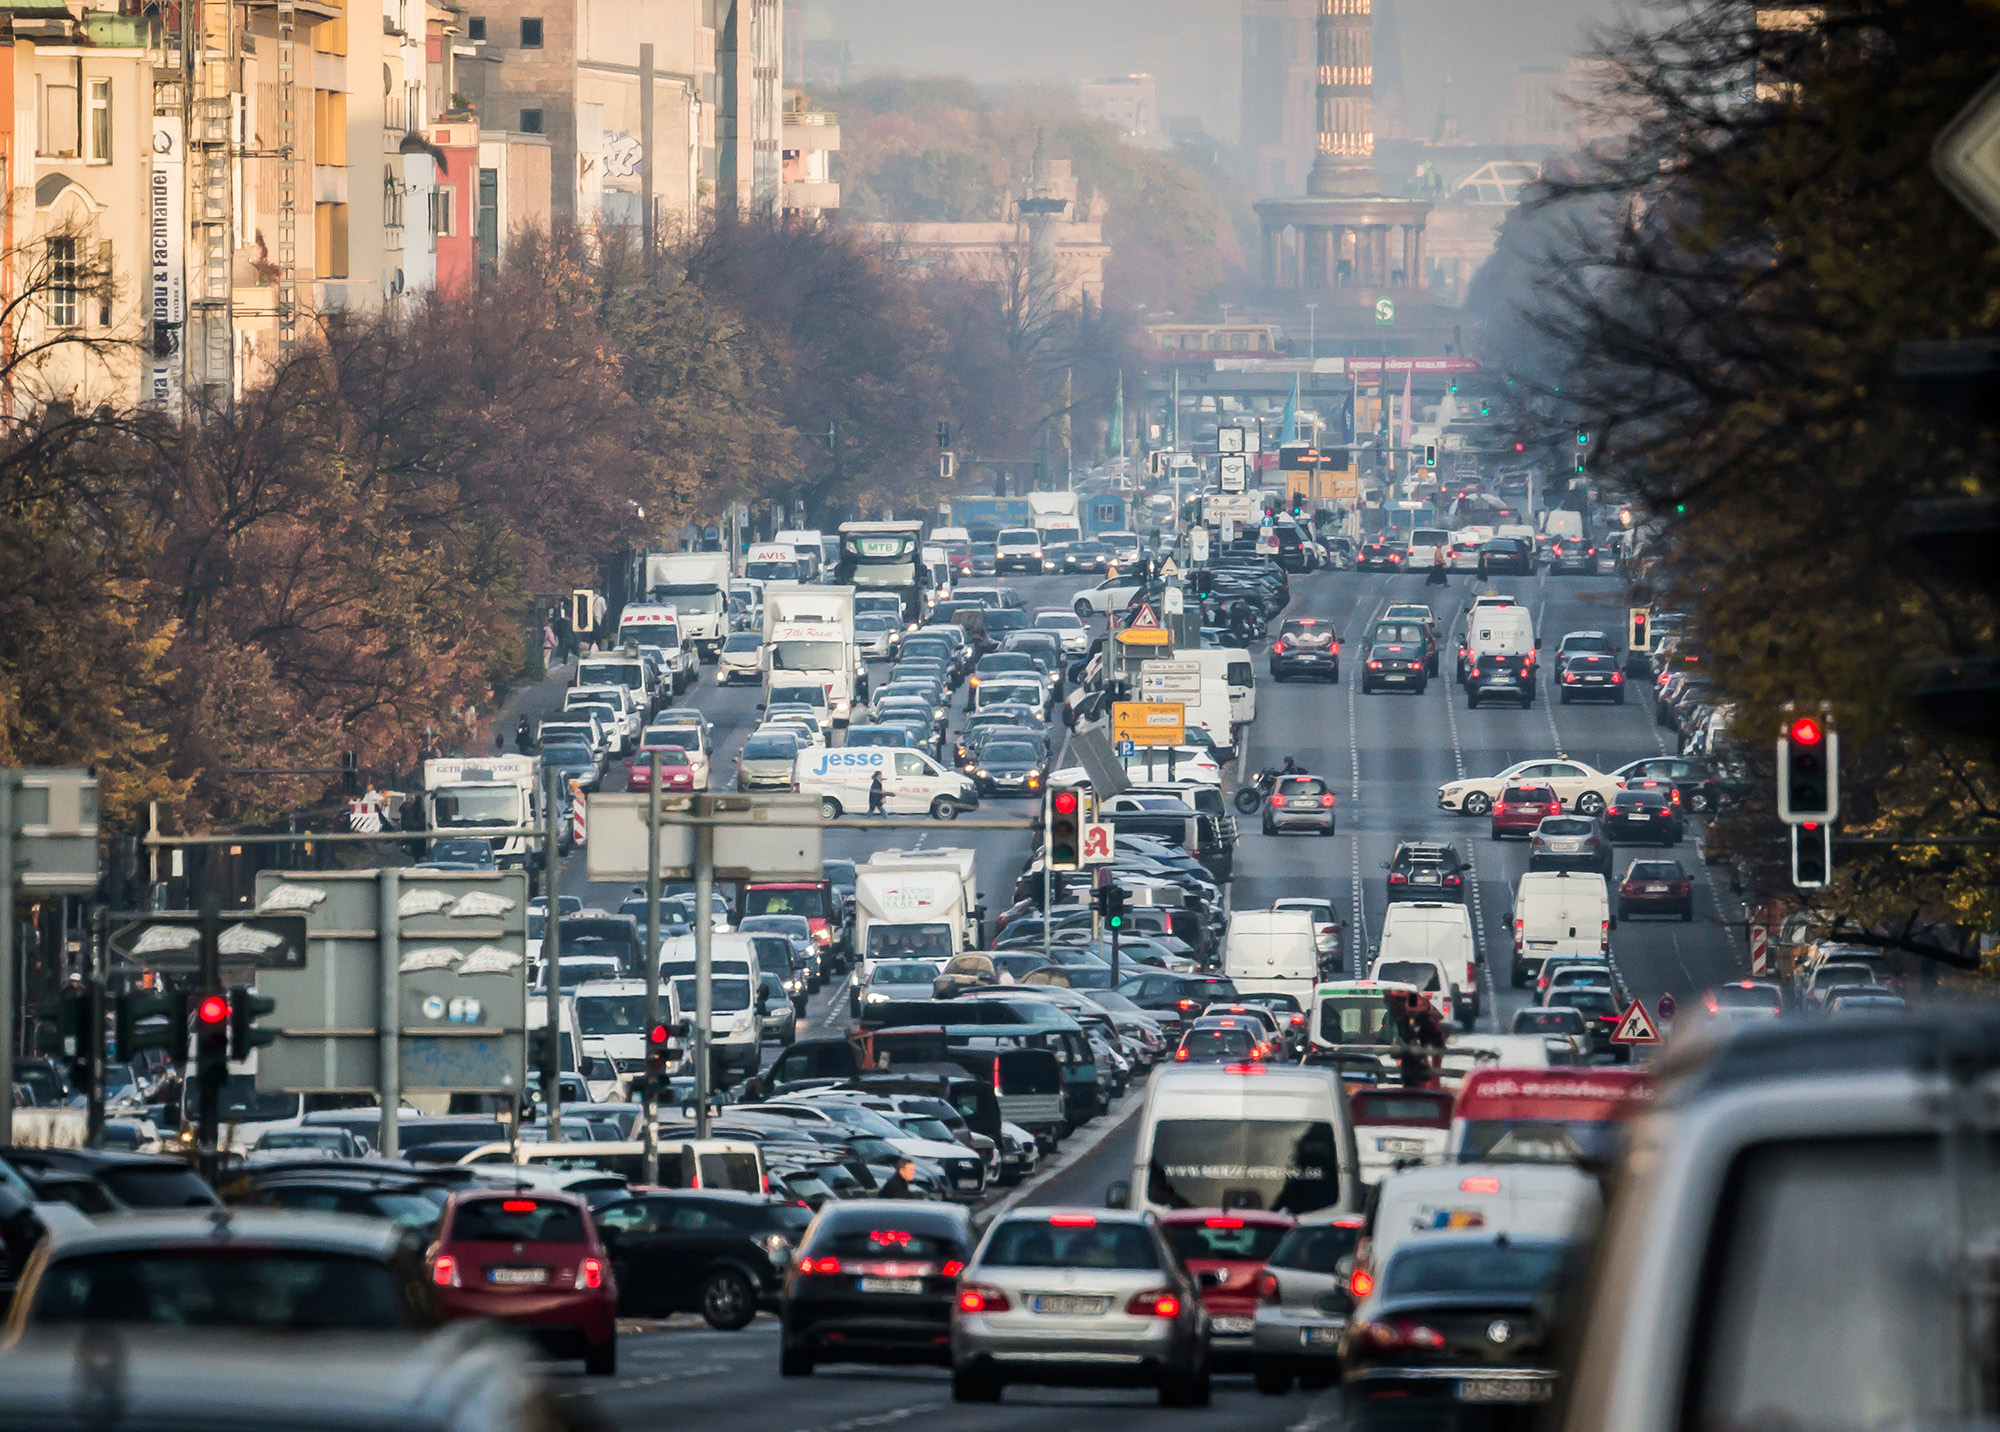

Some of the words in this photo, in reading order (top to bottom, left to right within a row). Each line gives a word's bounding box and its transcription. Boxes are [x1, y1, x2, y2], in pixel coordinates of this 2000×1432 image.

[153, 169, 168, 268] Fachhandel
[153, 272, 168, 283] &
[1376, 299, 1394, 320] S
[868, 543, 893, 552] MTB
[757, 552, 786, 560] AVIS
[1149, 716, 1177, 724] Zentrum
[1123, 742, 1132, 755] P
[1084, 826, 1110, 857] A
